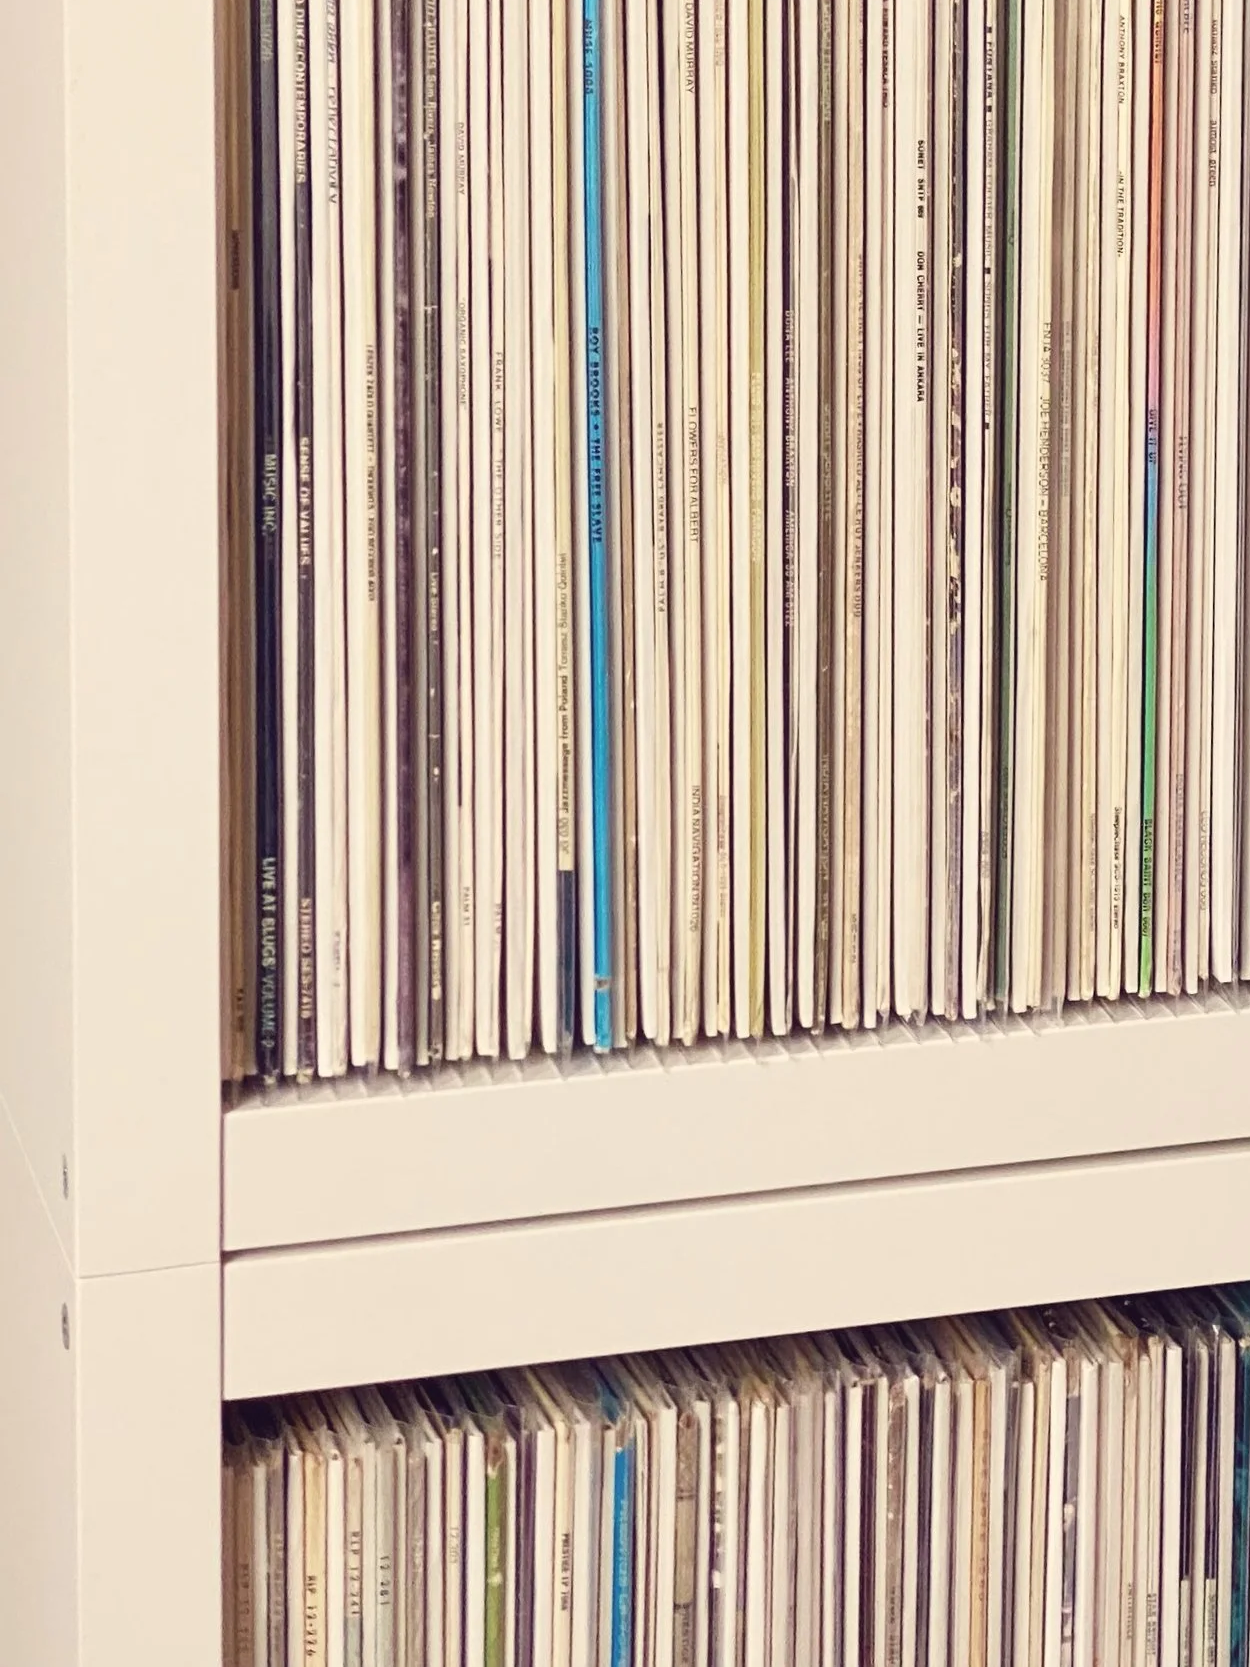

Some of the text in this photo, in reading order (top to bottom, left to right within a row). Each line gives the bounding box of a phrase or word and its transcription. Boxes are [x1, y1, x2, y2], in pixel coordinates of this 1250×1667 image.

[685, 2, 694, 94] DAVID MURRAY
[917, 140, 925, 170] SONET
[917, 251, 925, 402] DON CHERRY LIVE IN ANKARA
[495, 351, 503, 391] FRANK
[590, 326, 602, 543] ROY BROOKS THE FREE SLAVE
[262, 454, 277, 501] MUSIC
[688, 407, 699, 544] FLOWERS FOR ALBERT
[1038, 395, 1050, 581] JOE HENDERSON BARCELONA
[691, 785, 701, 815] INDIA
[1144, 818, 1153, 852] BLACK
[262, 857, 276, 889] LIVE
[262, 894, 276, 913] AT
